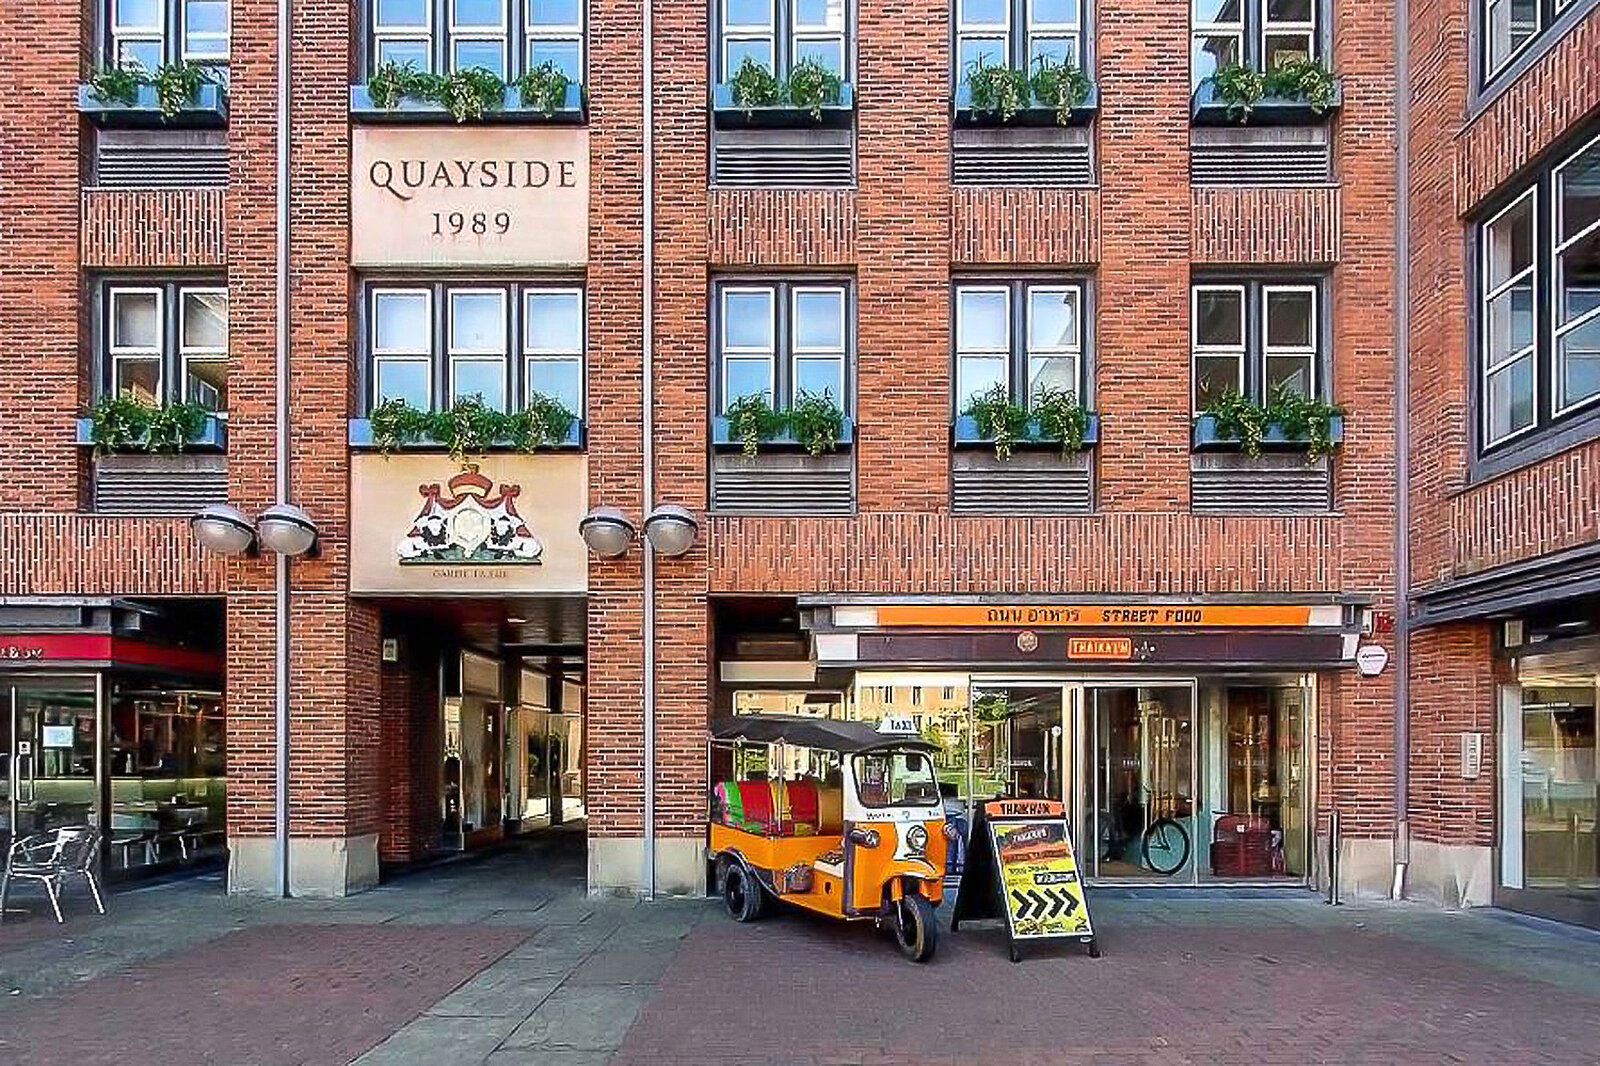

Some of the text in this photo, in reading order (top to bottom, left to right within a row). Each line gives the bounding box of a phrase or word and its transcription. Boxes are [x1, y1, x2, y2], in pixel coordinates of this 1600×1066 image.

[369, 160, 577, 201] QUAYSIDE
[432, 211, 511, 236] 1989
[1101, 609, 1202, 622] STREET FOOD
